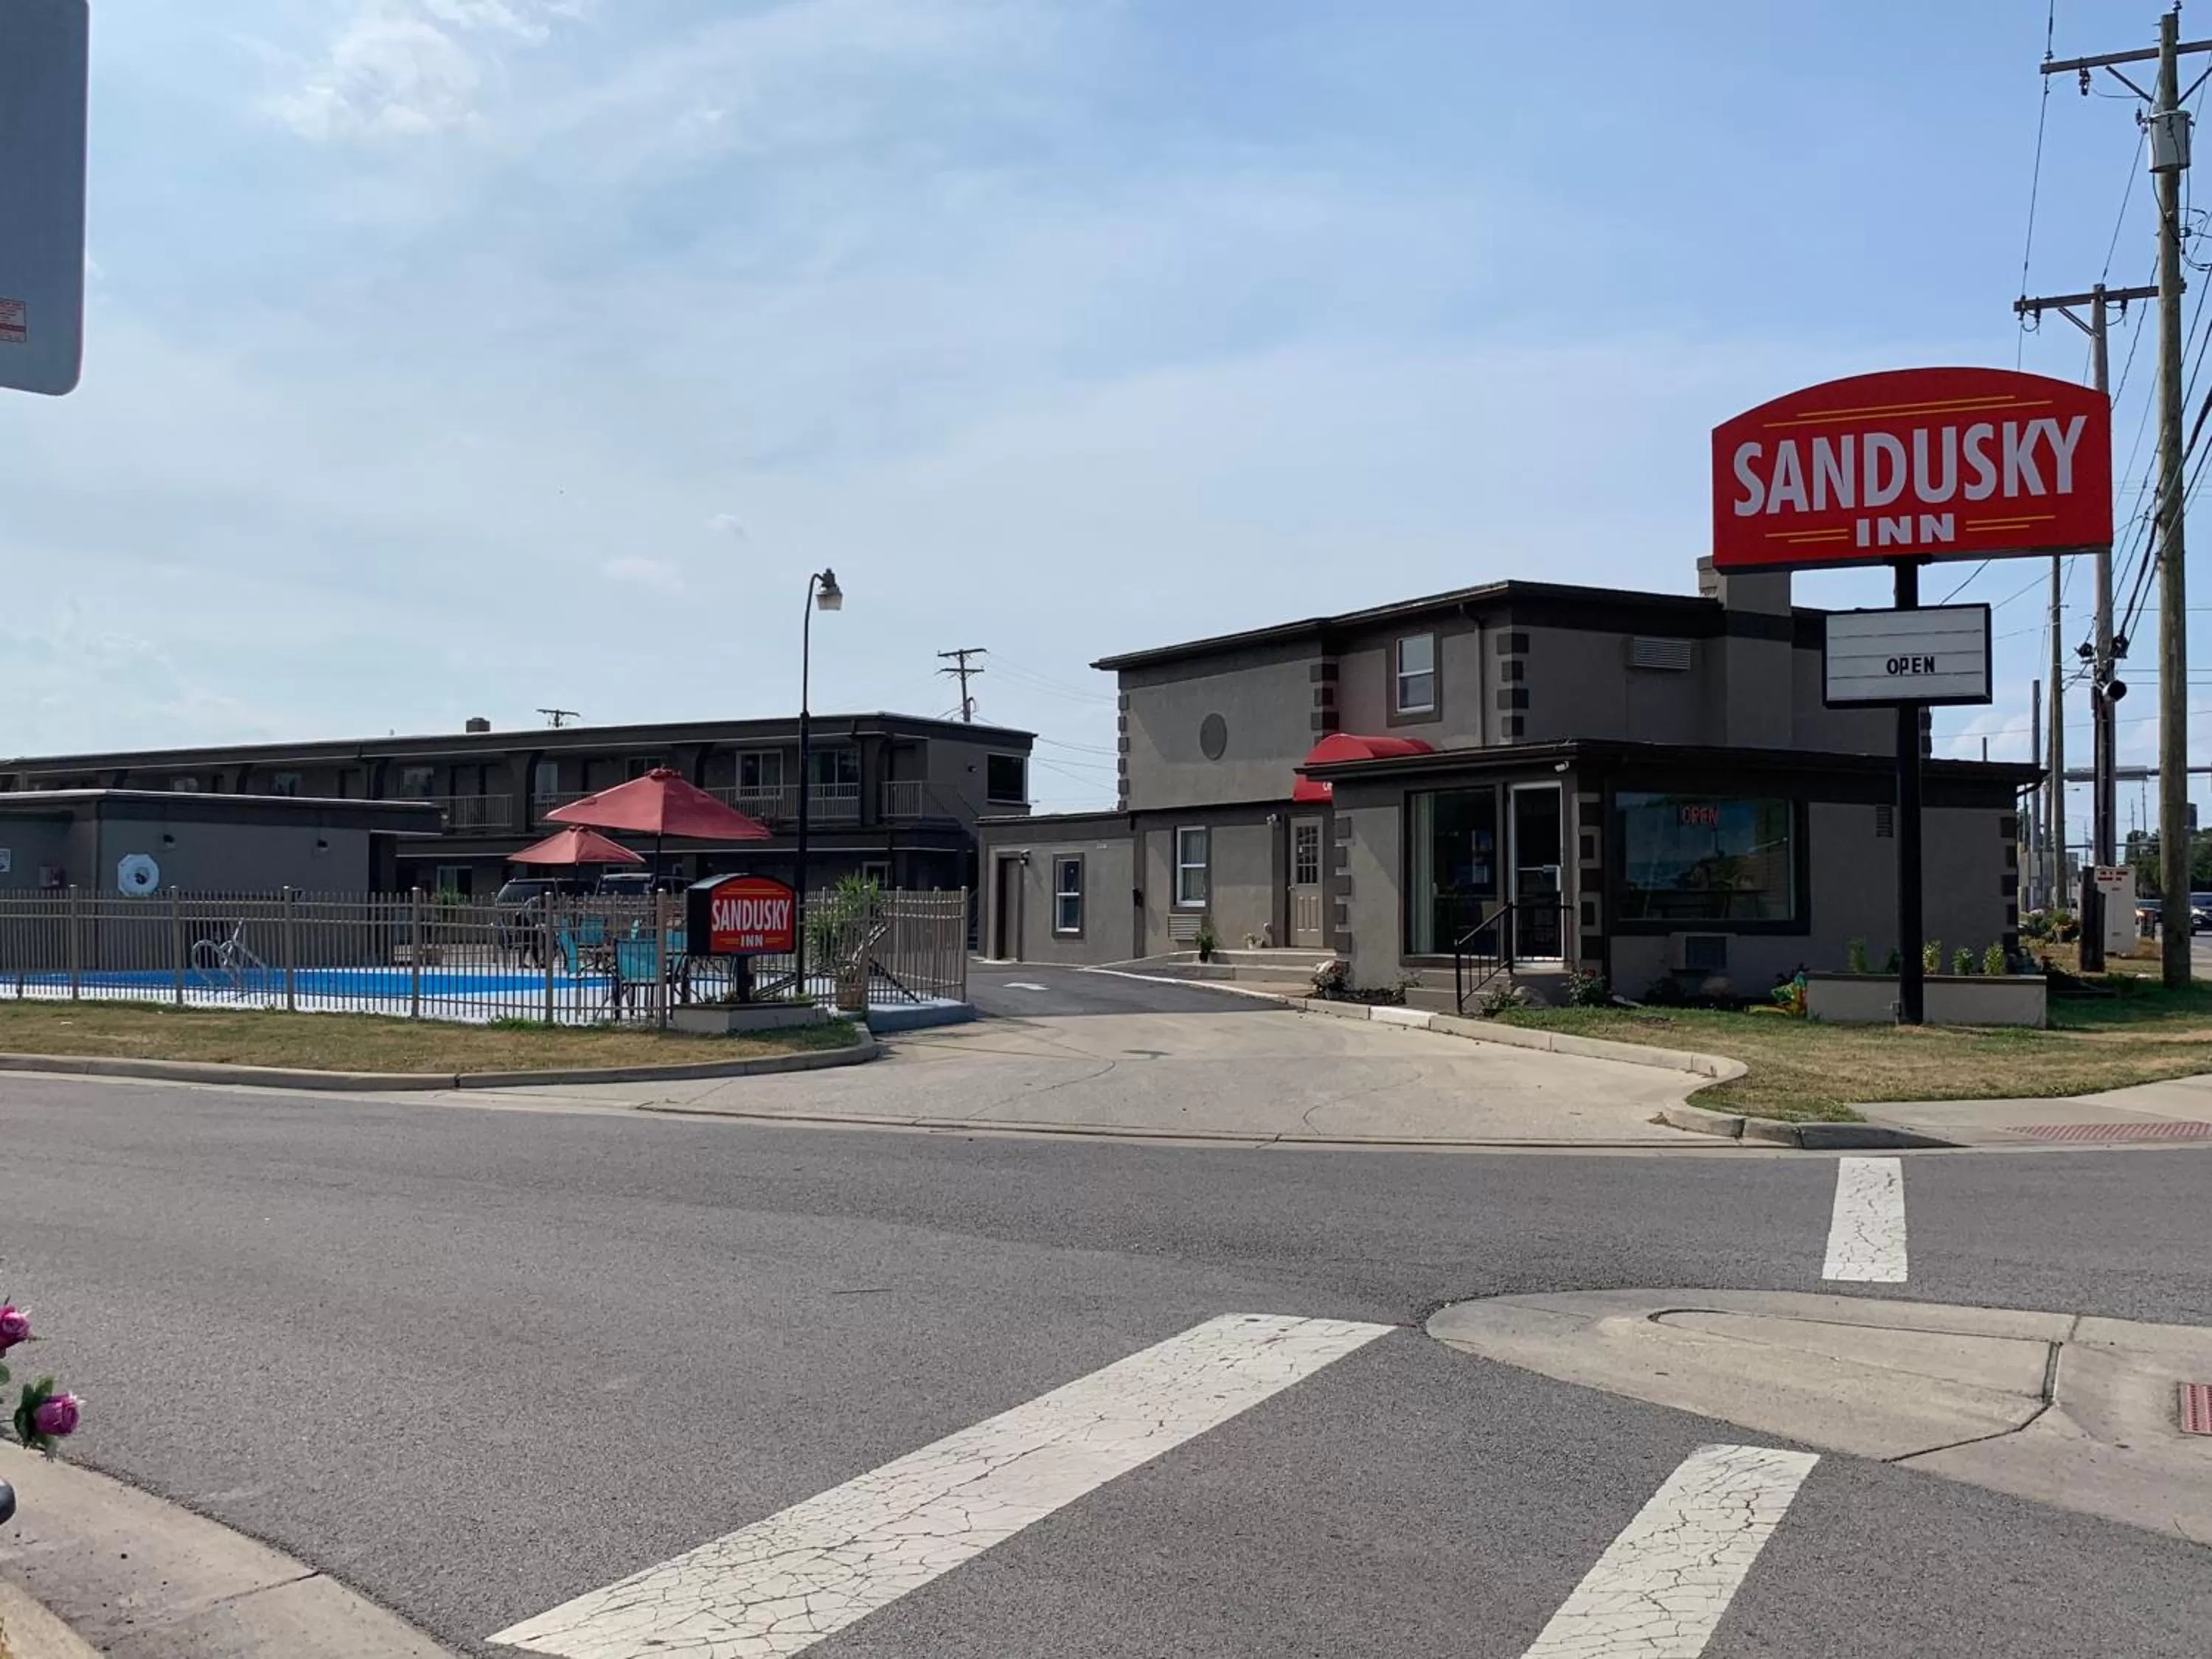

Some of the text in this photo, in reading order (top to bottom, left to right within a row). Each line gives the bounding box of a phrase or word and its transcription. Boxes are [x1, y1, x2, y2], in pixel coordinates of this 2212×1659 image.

[1733, 415, 2088, 517] SANDUSKY
[1856, 513, 1955, 547] INN
[1886, 655, 1935, 676] OPEN
[1682, 804, 1718, 826] OPEN
[712, 899, 791, 931] SANDUSKY
[740, 934, 764, 947] INN
